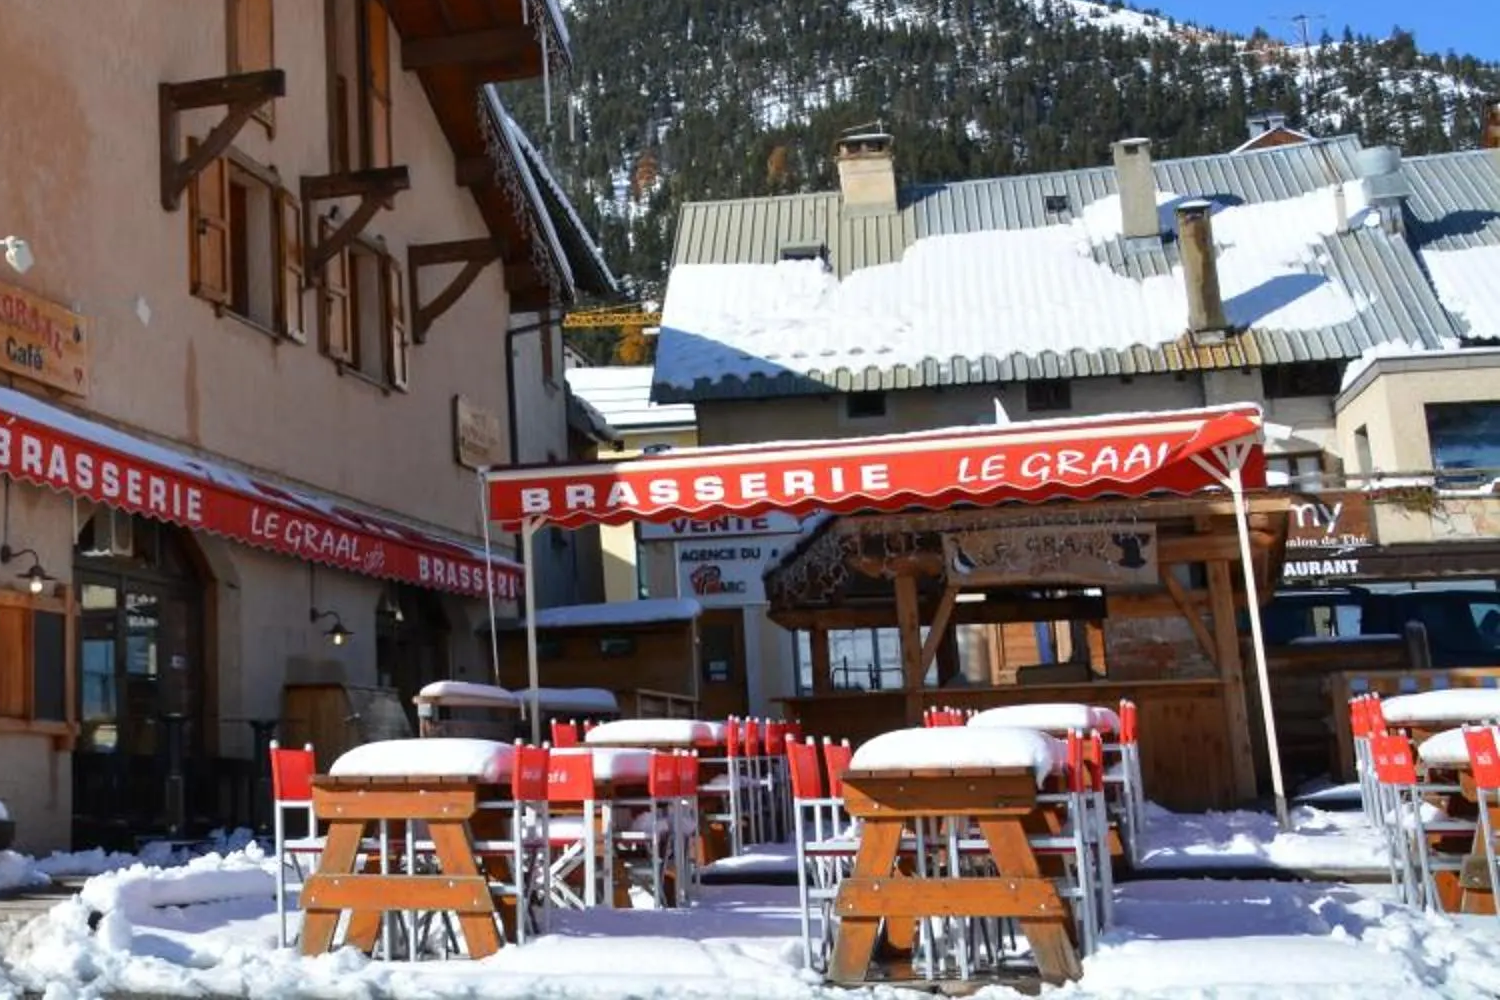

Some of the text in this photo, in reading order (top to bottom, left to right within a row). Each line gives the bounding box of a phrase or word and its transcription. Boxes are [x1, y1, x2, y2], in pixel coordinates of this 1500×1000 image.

[5, 336, 44, 371] Café
[520, 463, 890, 514] BRASSERIE
[957, 454, 1007, 484] LE
[251, 508, 280, 539] LE
[284, 519, 362, 563] GRAAL
[670, 516, 770, 534] VENTE
[681, 548, 736, 563] AGENCE
[742, 547, 761, 561] DU
